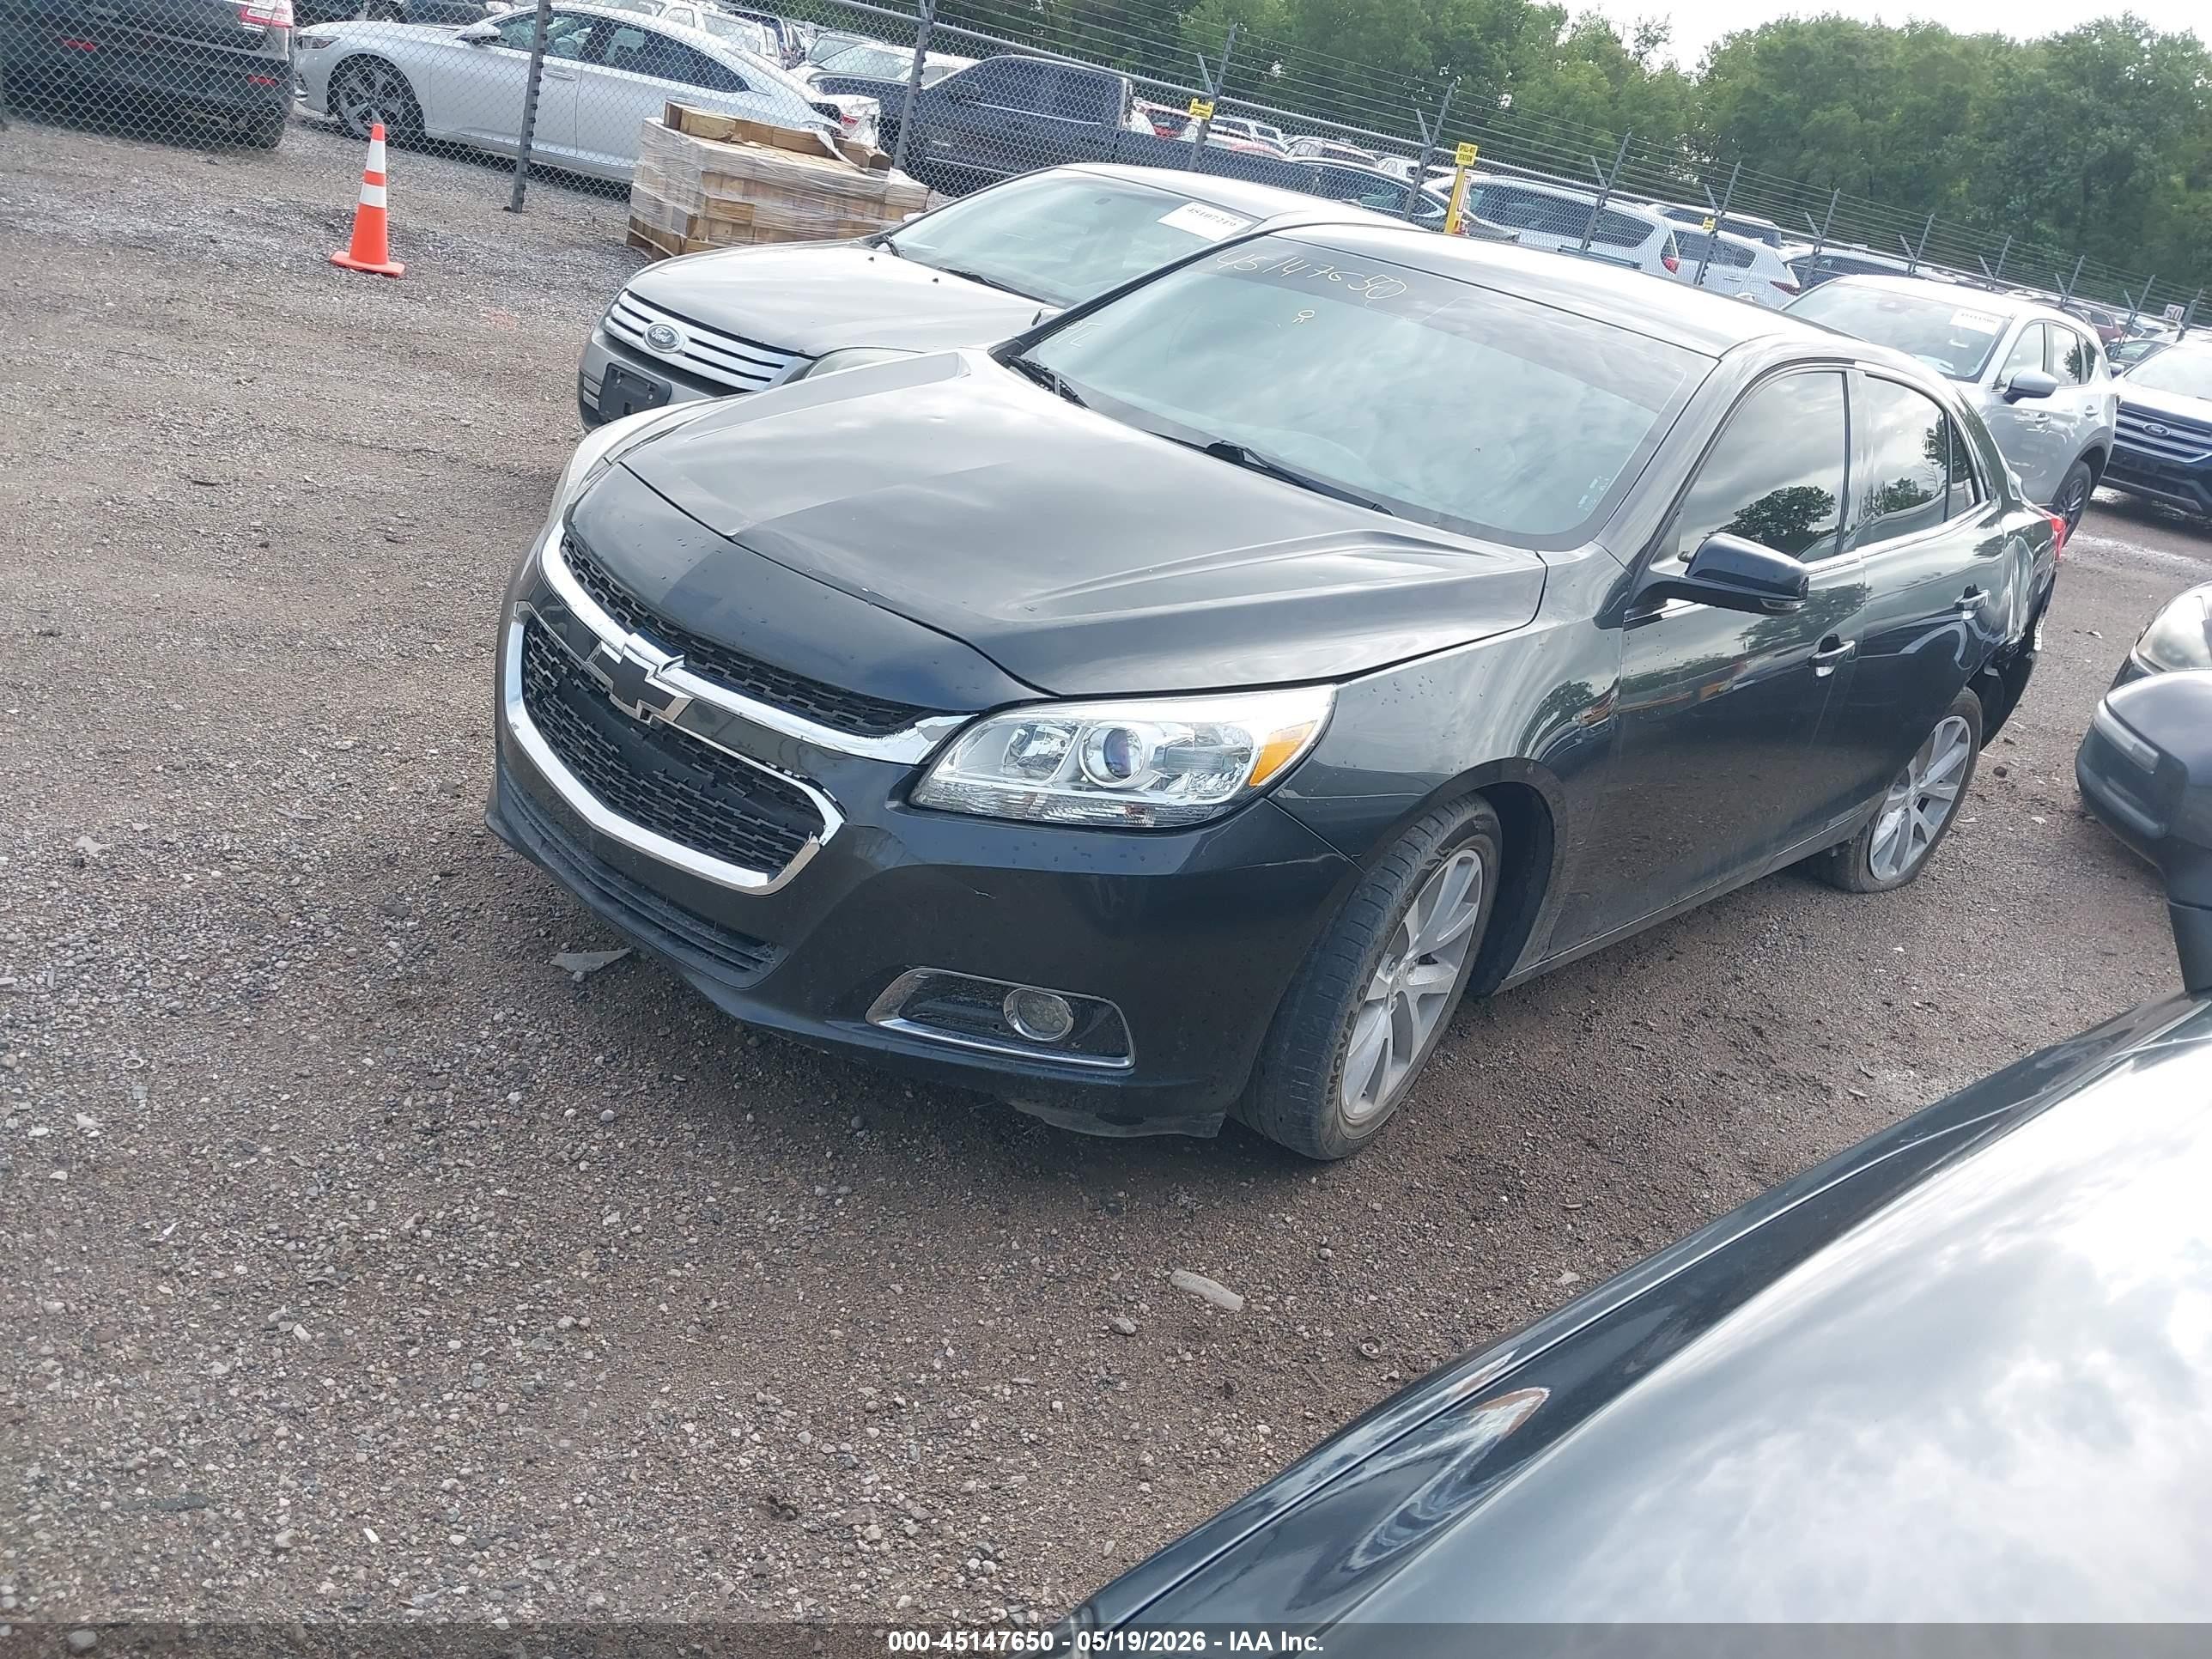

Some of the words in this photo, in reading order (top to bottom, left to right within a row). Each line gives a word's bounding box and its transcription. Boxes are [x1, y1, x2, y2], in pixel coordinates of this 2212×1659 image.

[1216, 250, 1407, 300] 45147650
[2164, 307, 2182, 320] 50
[651, 327, 672, 343] Ford
